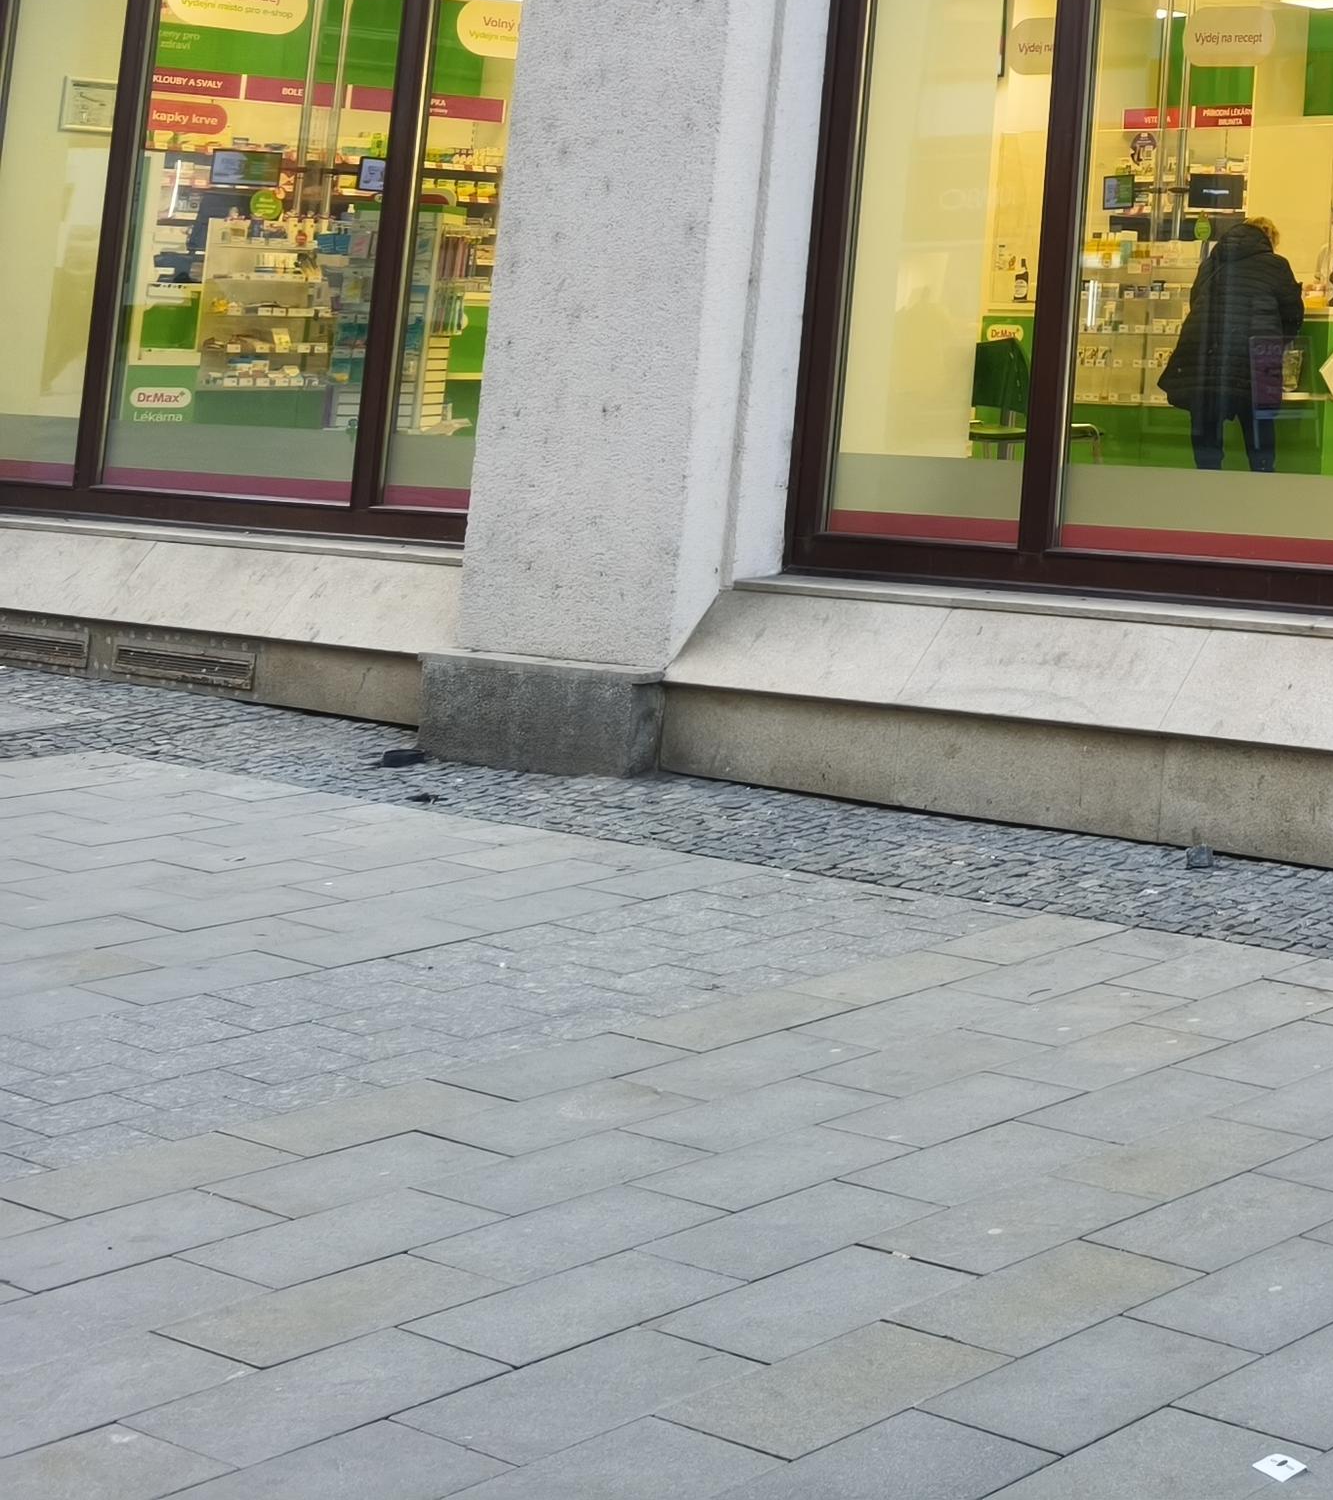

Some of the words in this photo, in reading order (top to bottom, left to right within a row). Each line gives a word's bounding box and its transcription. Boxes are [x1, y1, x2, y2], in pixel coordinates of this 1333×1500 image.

[483, 16, 516, 32] Volný
[1195, 31, 1221, 44] Výdej
[1222, 34, 1233, 43] na
[1234, 33, 1262, 45] recept
[1018, 41, 1042, 55] Výdej
[153, 74, 187, 86] KLOUBY
[188, 79, 196, 87] A
[196, 79, 224, 90] SVALY
[281, 86, 304, 97] BOLE
[152, 109, 189, 125] kapky
[191, 114, 219, 126] krve
[1231, 107, 1252, 116] LÉKÁRN
[1144, 116, 1172, 124] VETEA
[133, 411, 183, 422] Lékárna
